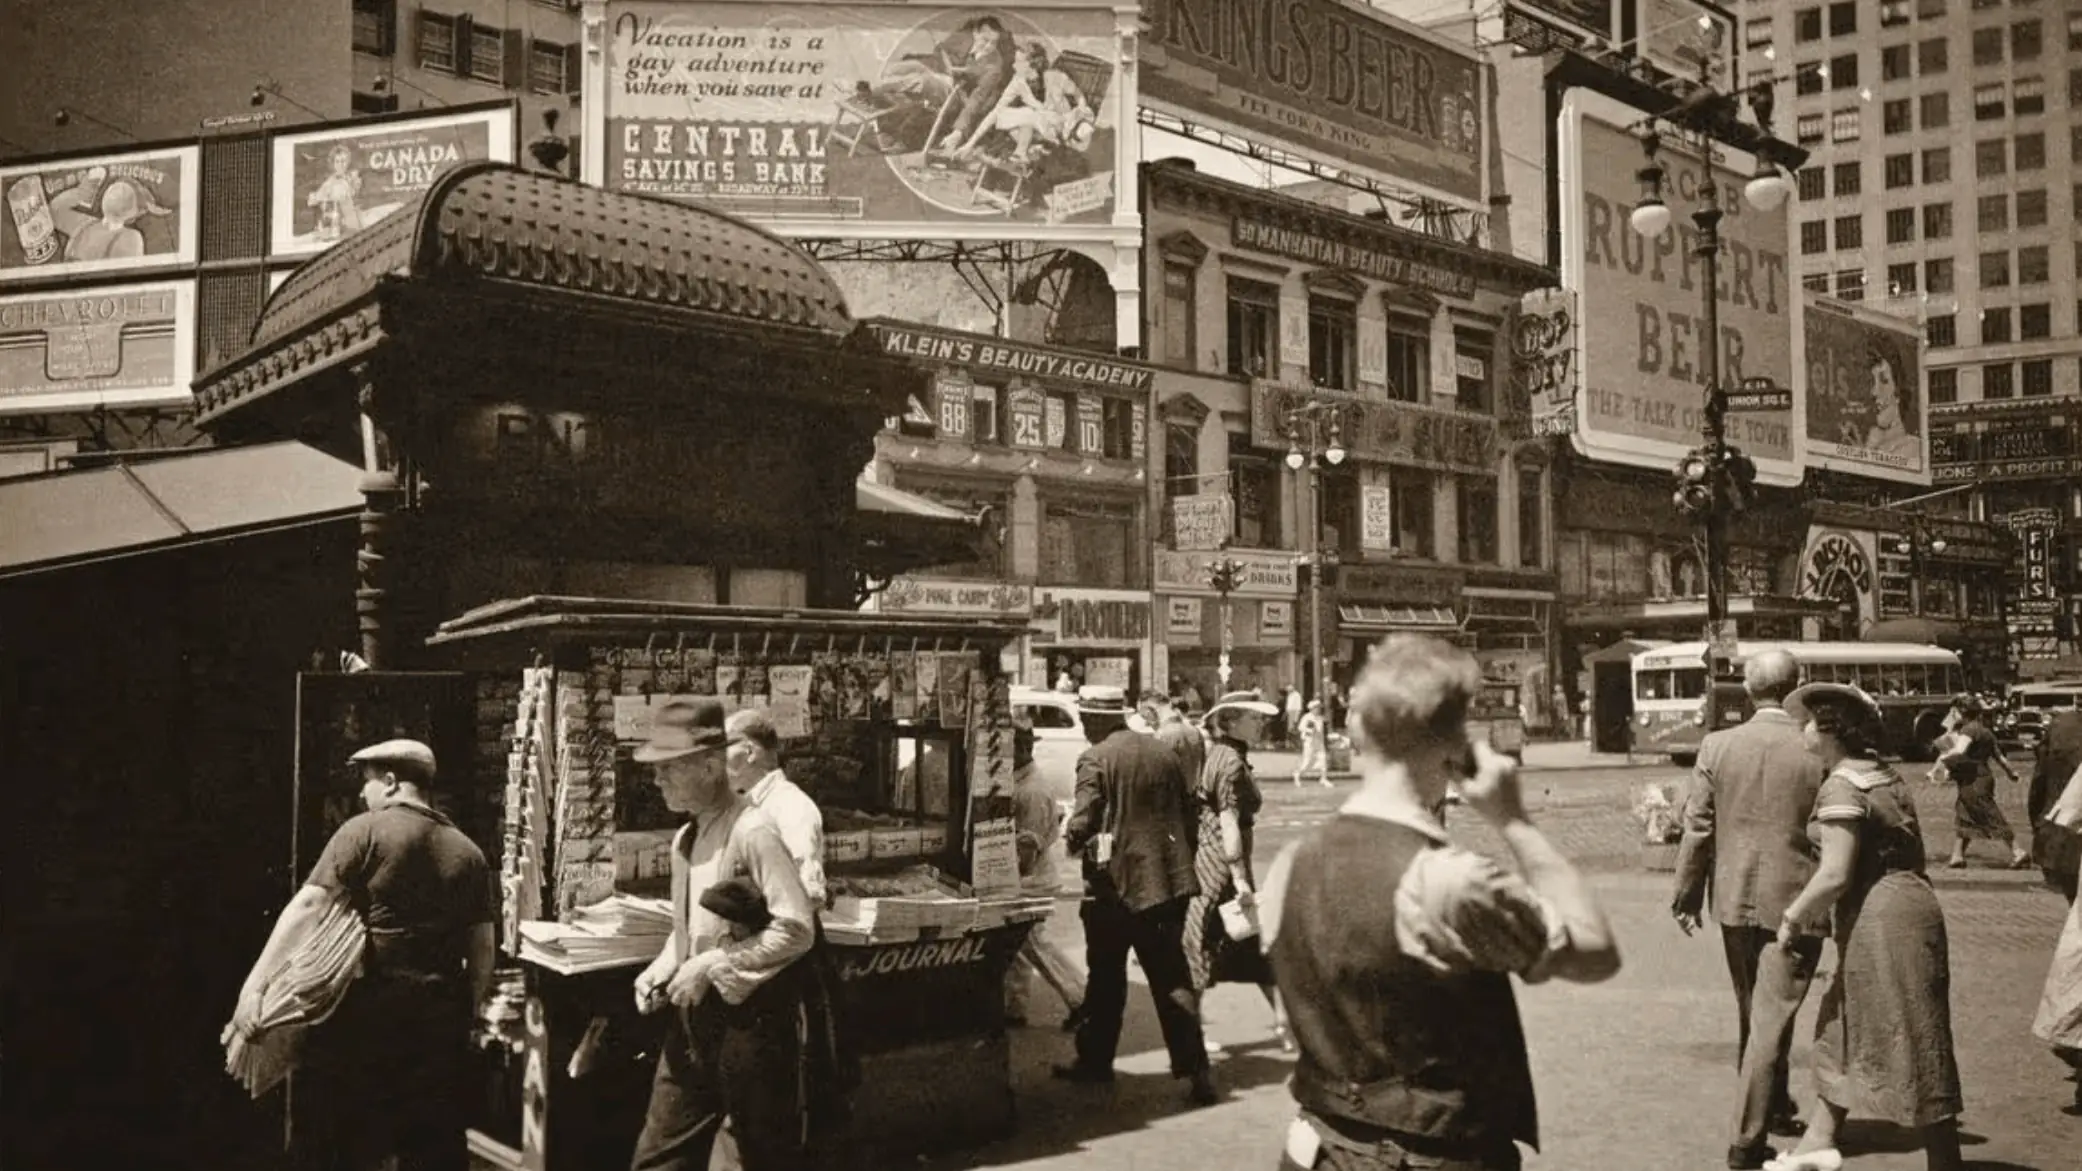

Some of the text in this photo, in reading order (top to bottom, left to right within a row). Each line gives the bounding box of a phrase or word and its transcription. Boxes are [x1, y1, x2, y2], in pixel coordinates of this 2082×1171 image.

[615, 12, 824, 50] Vacation is a
[625, 52, 824, 80] gay adventure
[1326, 14, 1438, 142] BEER
[625, 75, 823, 103] when you save at
[623, 123, 826, 158] CENTRAL
[1313, 120, 1325, 133] A
[369, 142, 459, 170] CANADA
[623, 158, 826, 184] SAVINGS BANK
[392, 163, 437, 185] DRY
[1257, 222, 1345, 265] MANHATTAN
[1350, 247, 1402, 279] BEAUTY
[1408, 262, 1459, 291] SCHOOL
[0, 293, 171, 329] CHEVROLET
[885, 331, 1148, 389] KLEIN'S BEAUTY ACADEMY
[1728, 394, 1760, 406] UNION
[1762, 394, 1778, 405] SQ
[940, 402, 966, 435] 88
[1014, 412, 1044, 448] 25
[1587, 388, 1626, 418] THE
[1631, 397, 1676, 429] TALK
[1745, 418, 1789, 449] TOWN
[1989, 464, 2001, 477] A
[2006, 460, 2065, 475] PROFIT
[1249, 572, 1293, 587] DRINKS
[2029, 531, 2044, 597] FURS
[857, 936, 986, 976] JOURNAL
